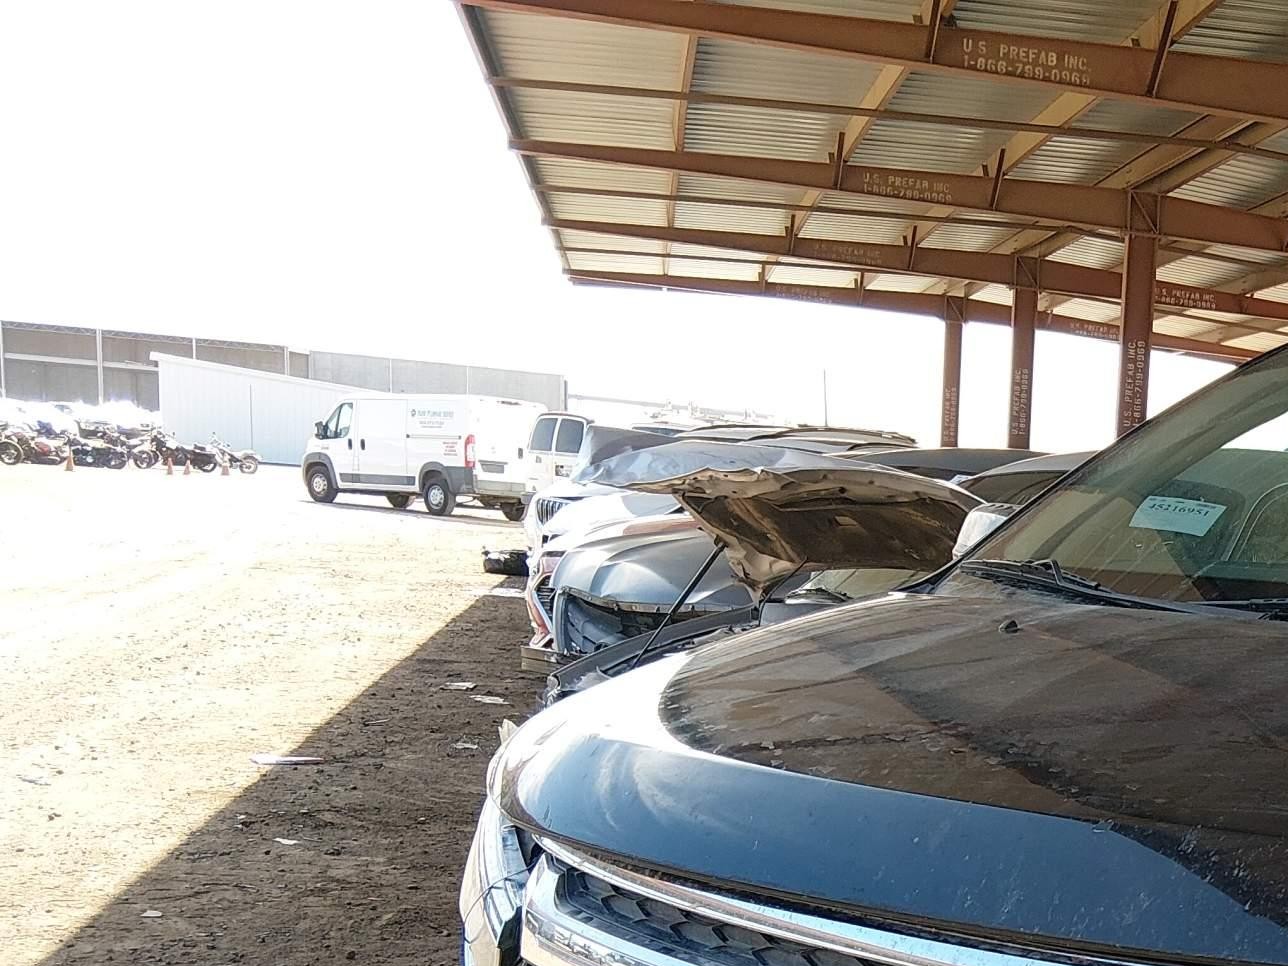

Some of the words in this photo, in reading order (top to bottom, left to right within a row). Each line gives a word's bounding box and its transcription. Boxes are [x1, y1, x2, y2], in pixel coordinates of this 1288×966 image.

[999, 44, 1058, 67] PREFAB
[1064, 54, 1093, 72] INC.
[1127, 339, 1137, 359] INC.
[1124, 363, 1135, 403] PREFAB
